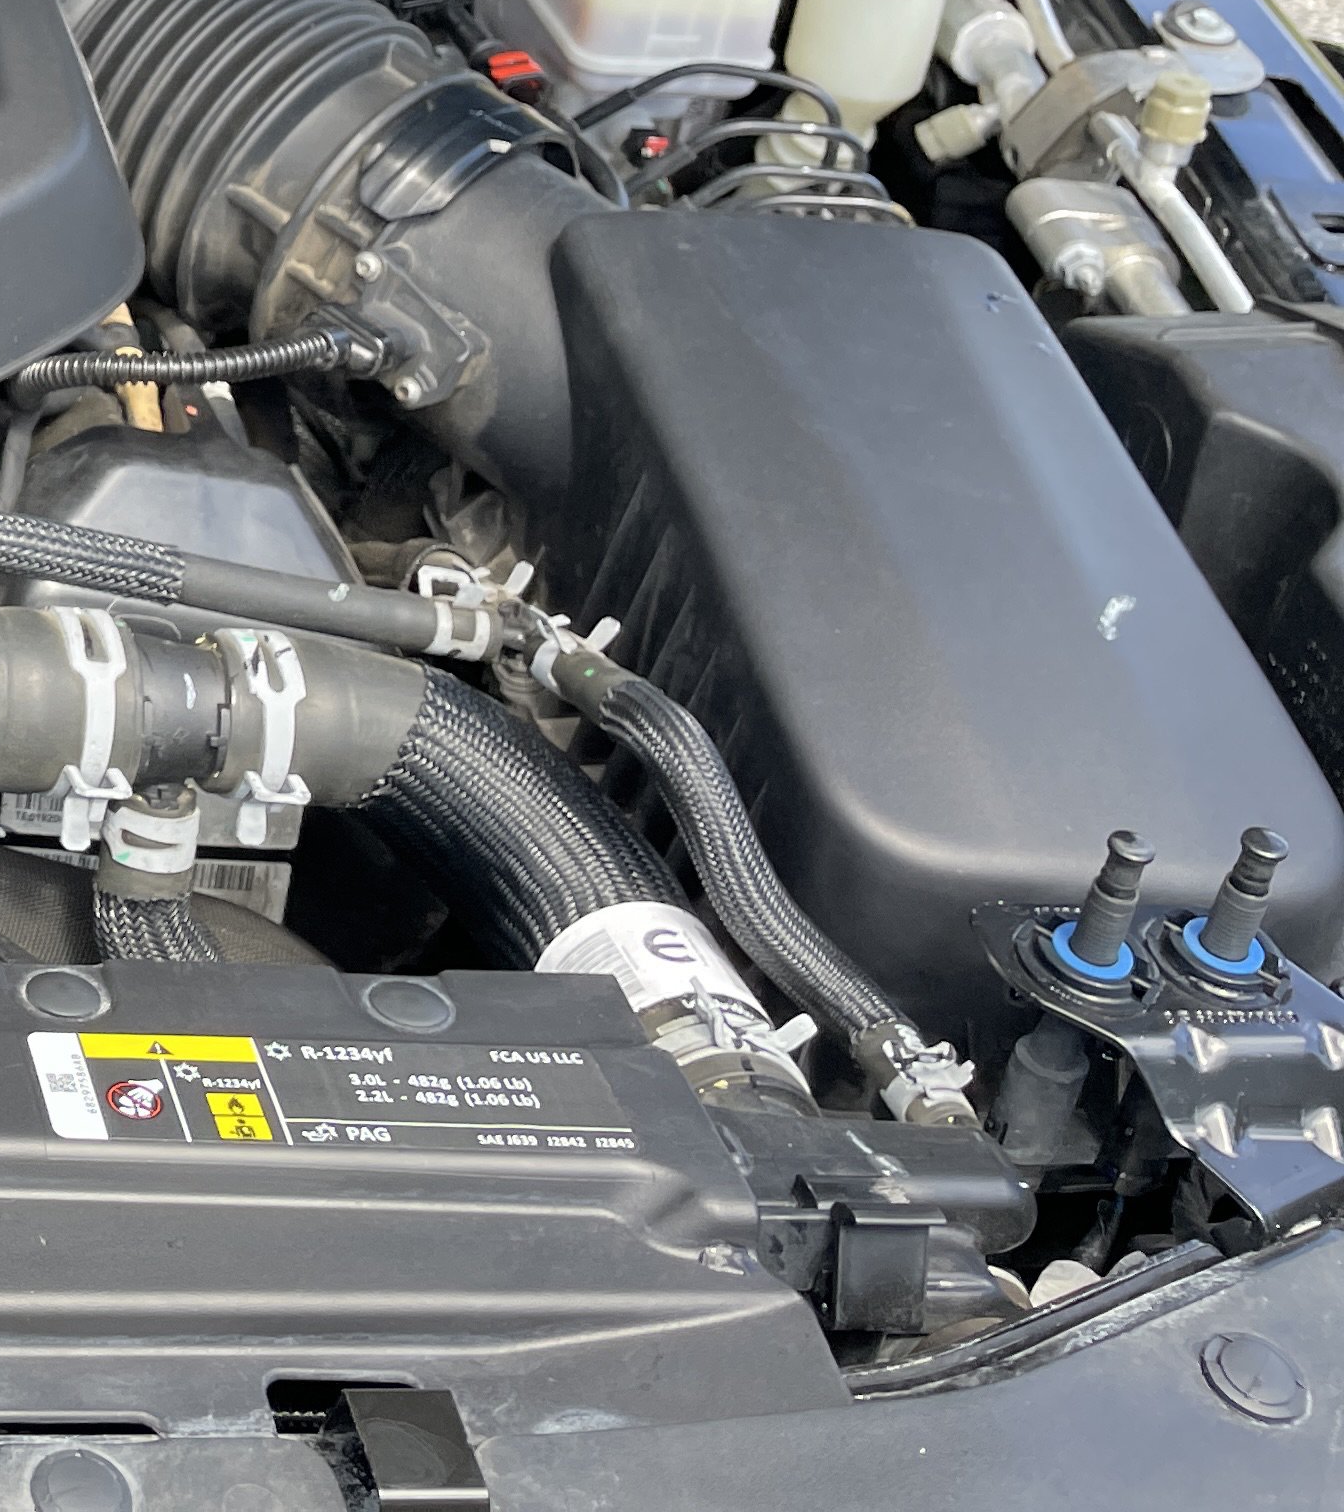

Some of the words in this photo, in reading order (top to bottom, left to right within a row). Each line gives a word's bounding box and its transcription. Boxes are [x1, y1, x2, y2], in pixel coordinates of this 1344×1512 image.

[300, 1045, 393, 1064] R-1234yf
[489, 1050, 524, 1064] FCA
[526, 1051, 551, 1064] US
[553, 1052, 584, 1065] LLC
[348, 1073, 387, 1086] 3.0L
[408, 1074, 451, 1089] 482g
[456, 1075, 501, 1090] (1.06
[355, 1089, 394, 1103] 2.2L
[415, 1091, 459, 1107] 482g
[464, 1092, 510, 1107] (1.06
[346, 1126, 392, 1142] PAG
